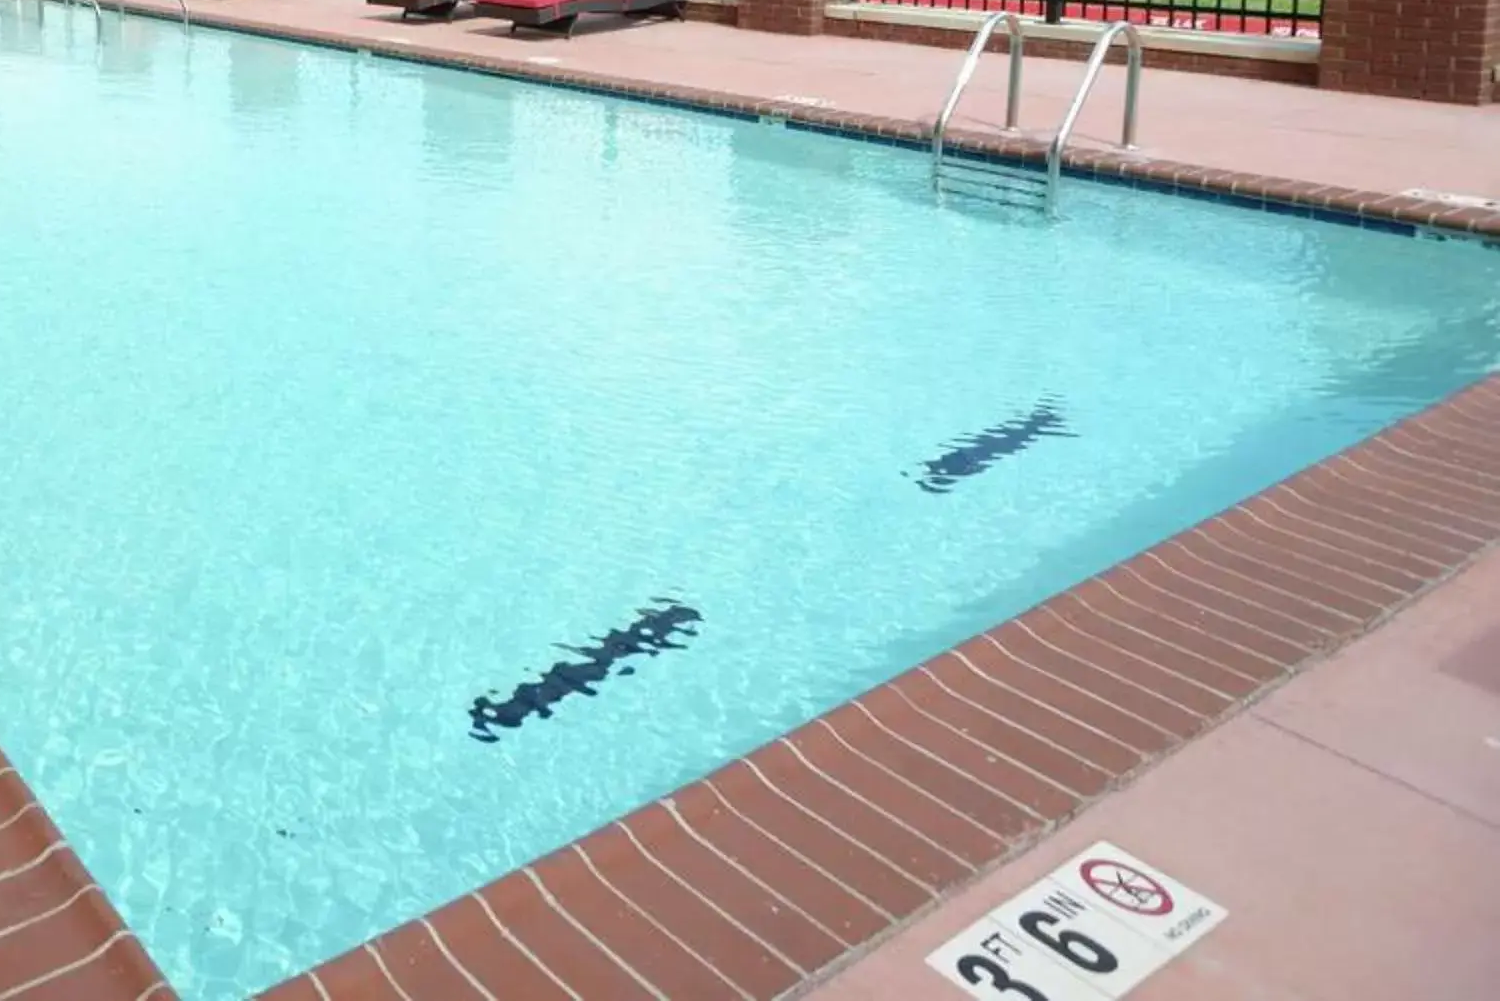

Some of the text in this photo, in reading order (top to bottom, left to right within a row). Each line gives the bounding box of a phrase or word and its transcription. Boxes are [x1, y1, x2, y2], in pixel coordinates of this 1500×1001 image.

[957, 930, 1049, 1001] 3 FT
[1018, 889, 1119, 974] 6 IN
